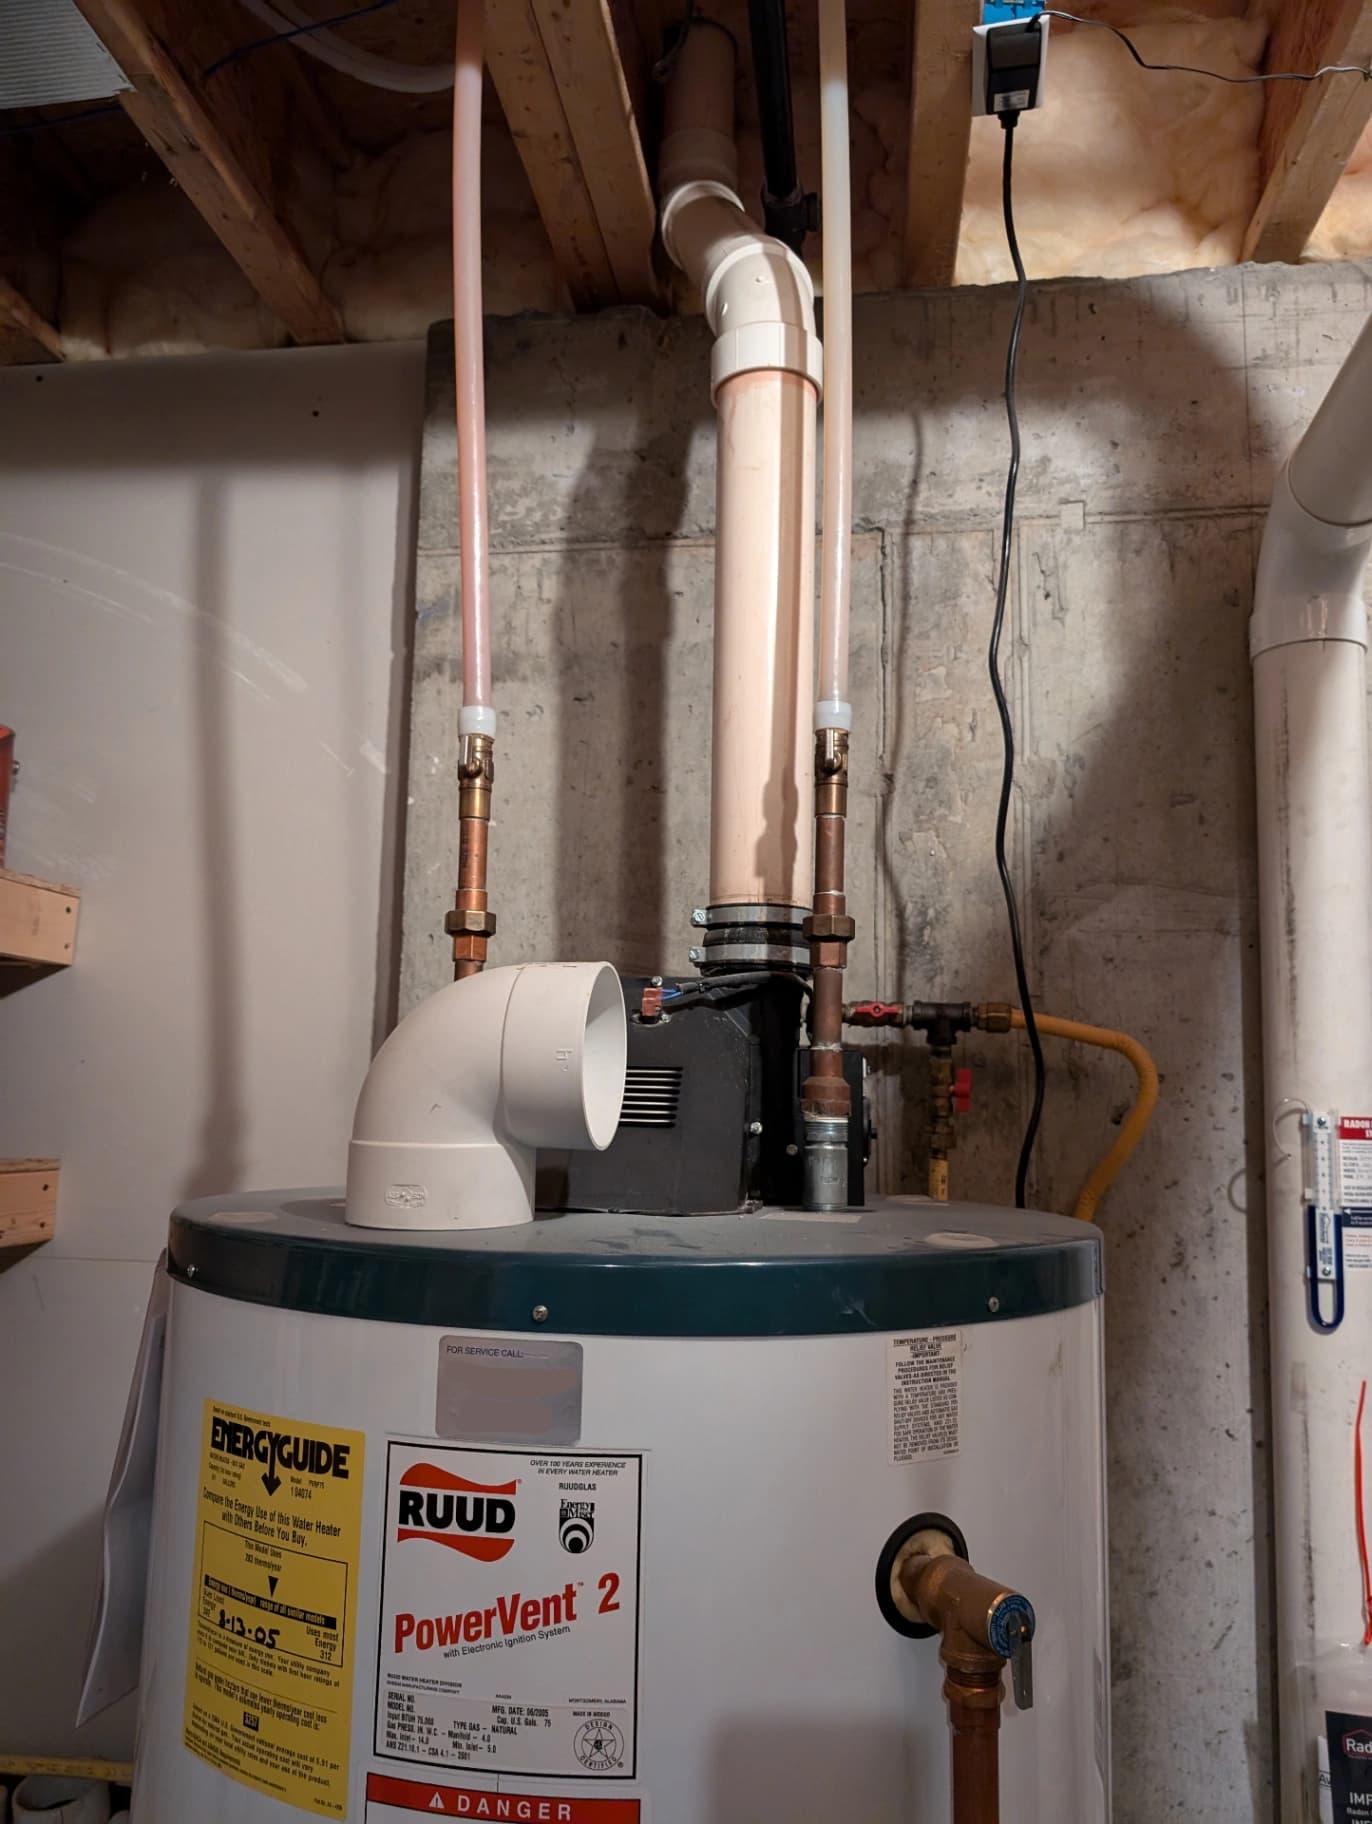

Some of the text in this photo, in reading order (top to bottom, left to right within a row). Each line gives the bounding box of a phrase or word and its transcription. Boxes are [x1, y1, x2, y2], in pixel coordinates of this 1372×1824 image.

[446, 1346, 524, 1358] FOR SERVICE CALL:
[211, 1416, 351, 1480] ENERGYGUIDE
[546, 1468, 567, 1476] EVERY
[568, 1469, 590, 1477] WATER
[562, 1461, 582, 1469] YEARS
[584, 1461, 627, 1469] EXPERIENCE
[558, 1483, 598, 1491] RUUDGLAS
[203, 1486, 342, 1537] Compare the Energy Use of this Water Heater
[398, 1489, 516, 1533] RUUD
[221, 1511, 308, 1548] with Others Before You Buy.
[597, 1572, 620, 1615] 2
[305, 1611, 325, 1625] models
[306, 1625, 338, 1642] Uses most
[315, 1638, 337, 1653] Energy
[443, 1625, 571, 1659] with Electronic Ignition System
[319, 1650, 332, 1661] 312
[388, 1691, 406, 1702] SERIAL
[387, 1701, 406, 1712] MODEL
[492, 1705, 507, 1715] MFG.
[508, 1707, 525, 1716] DATE:
[527, 1708, 549, 1717] 06/2005
[453, 1720, 518, 1736] TYPE GAS NATURAL
[510, 1716, 522, 1726] U.S.
[544, 1718, 552, 1728] 75
[584, 1719, 614, 1731] DESIGN
[487, 1744, 497, 1754] 5.0
[456, 1794, 571, 1821] DANGER
